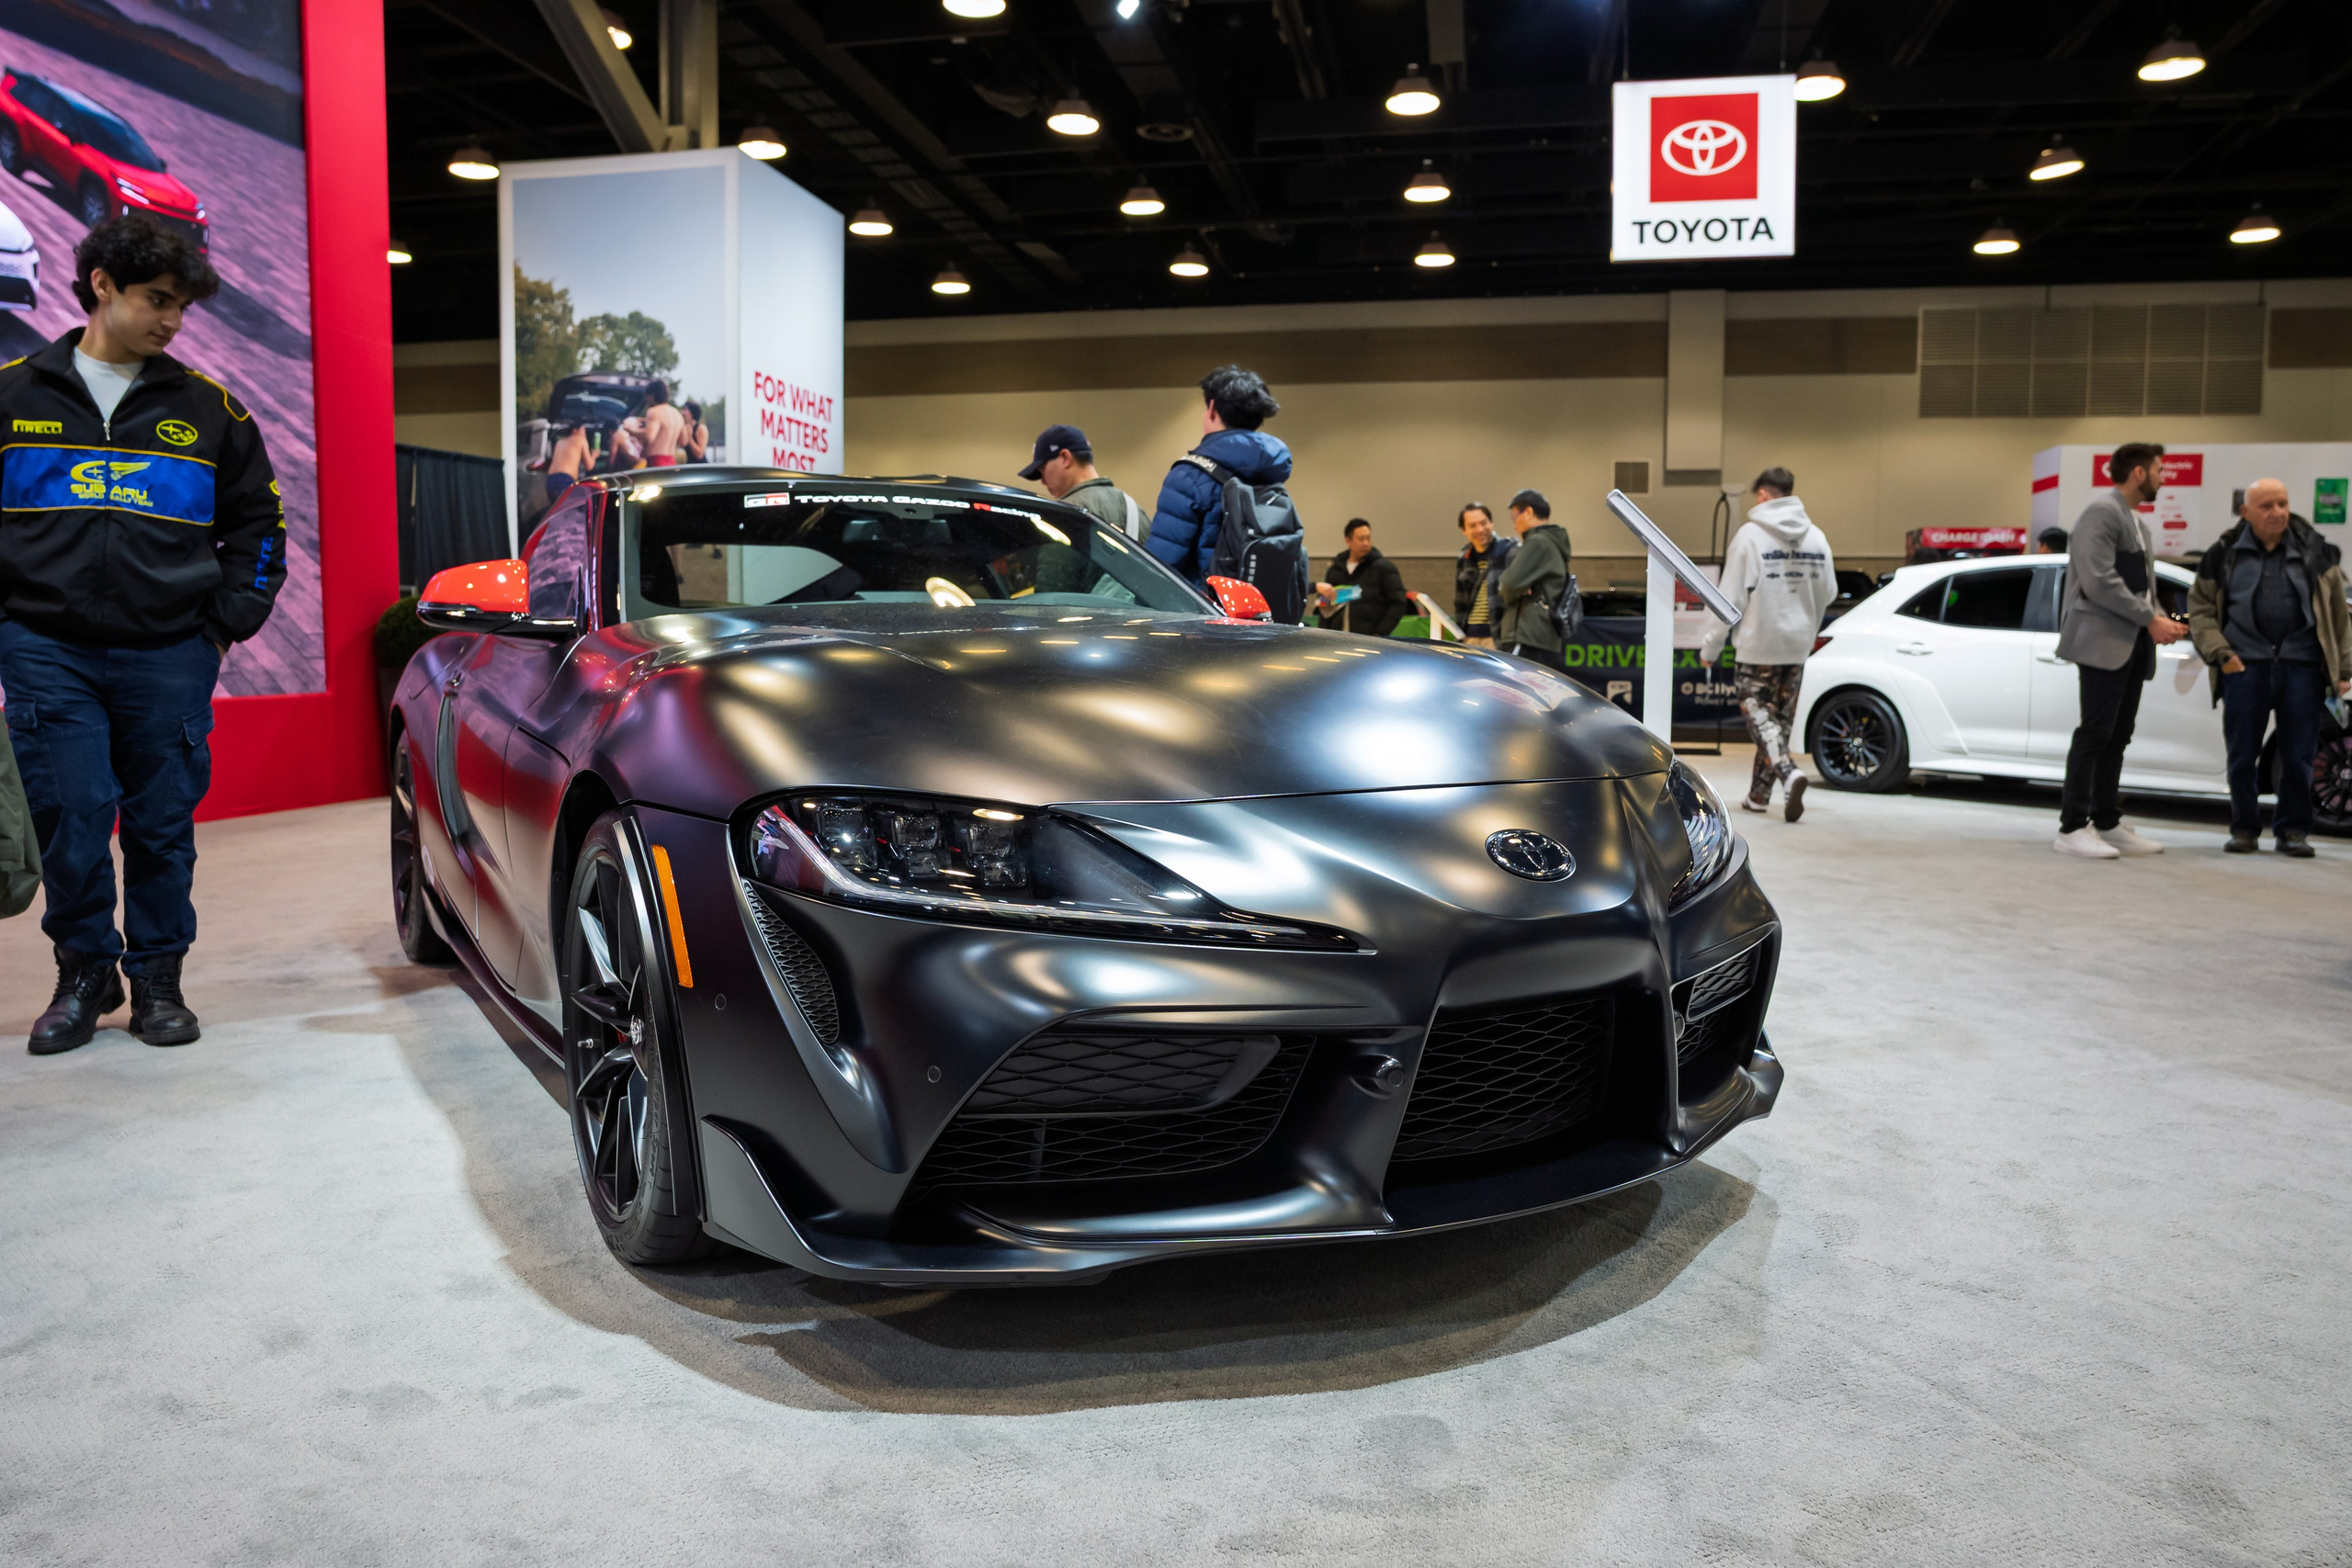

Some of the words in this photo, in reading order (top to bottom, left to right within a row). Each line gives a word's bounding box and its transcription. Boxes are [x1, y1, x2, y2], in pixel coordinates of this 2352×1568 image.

[1632, 218, 1774, 243] TOYOTA
[754, 371, 786, 409] FOR
[790, 384, 833, 423] WHAT
[13, 419, 62, 434] PIRELLI
[761, 408, 829, 454] MATTERS
[773, 446, 815, 471] MOST
[70, 483, 147, 501] SUBARU
[745, 493, 789, 508] GR
[794, 494, 889, 503] TOYOTA
[891, 495, 971, 509] GAZOO
[973, 502, 1041, 520] Racing
[1930, 531, 1978, 544] CHARGE
[1565, 644, 1645, 669] DRIVE
[649, 1134, 659, 1178] Sport
